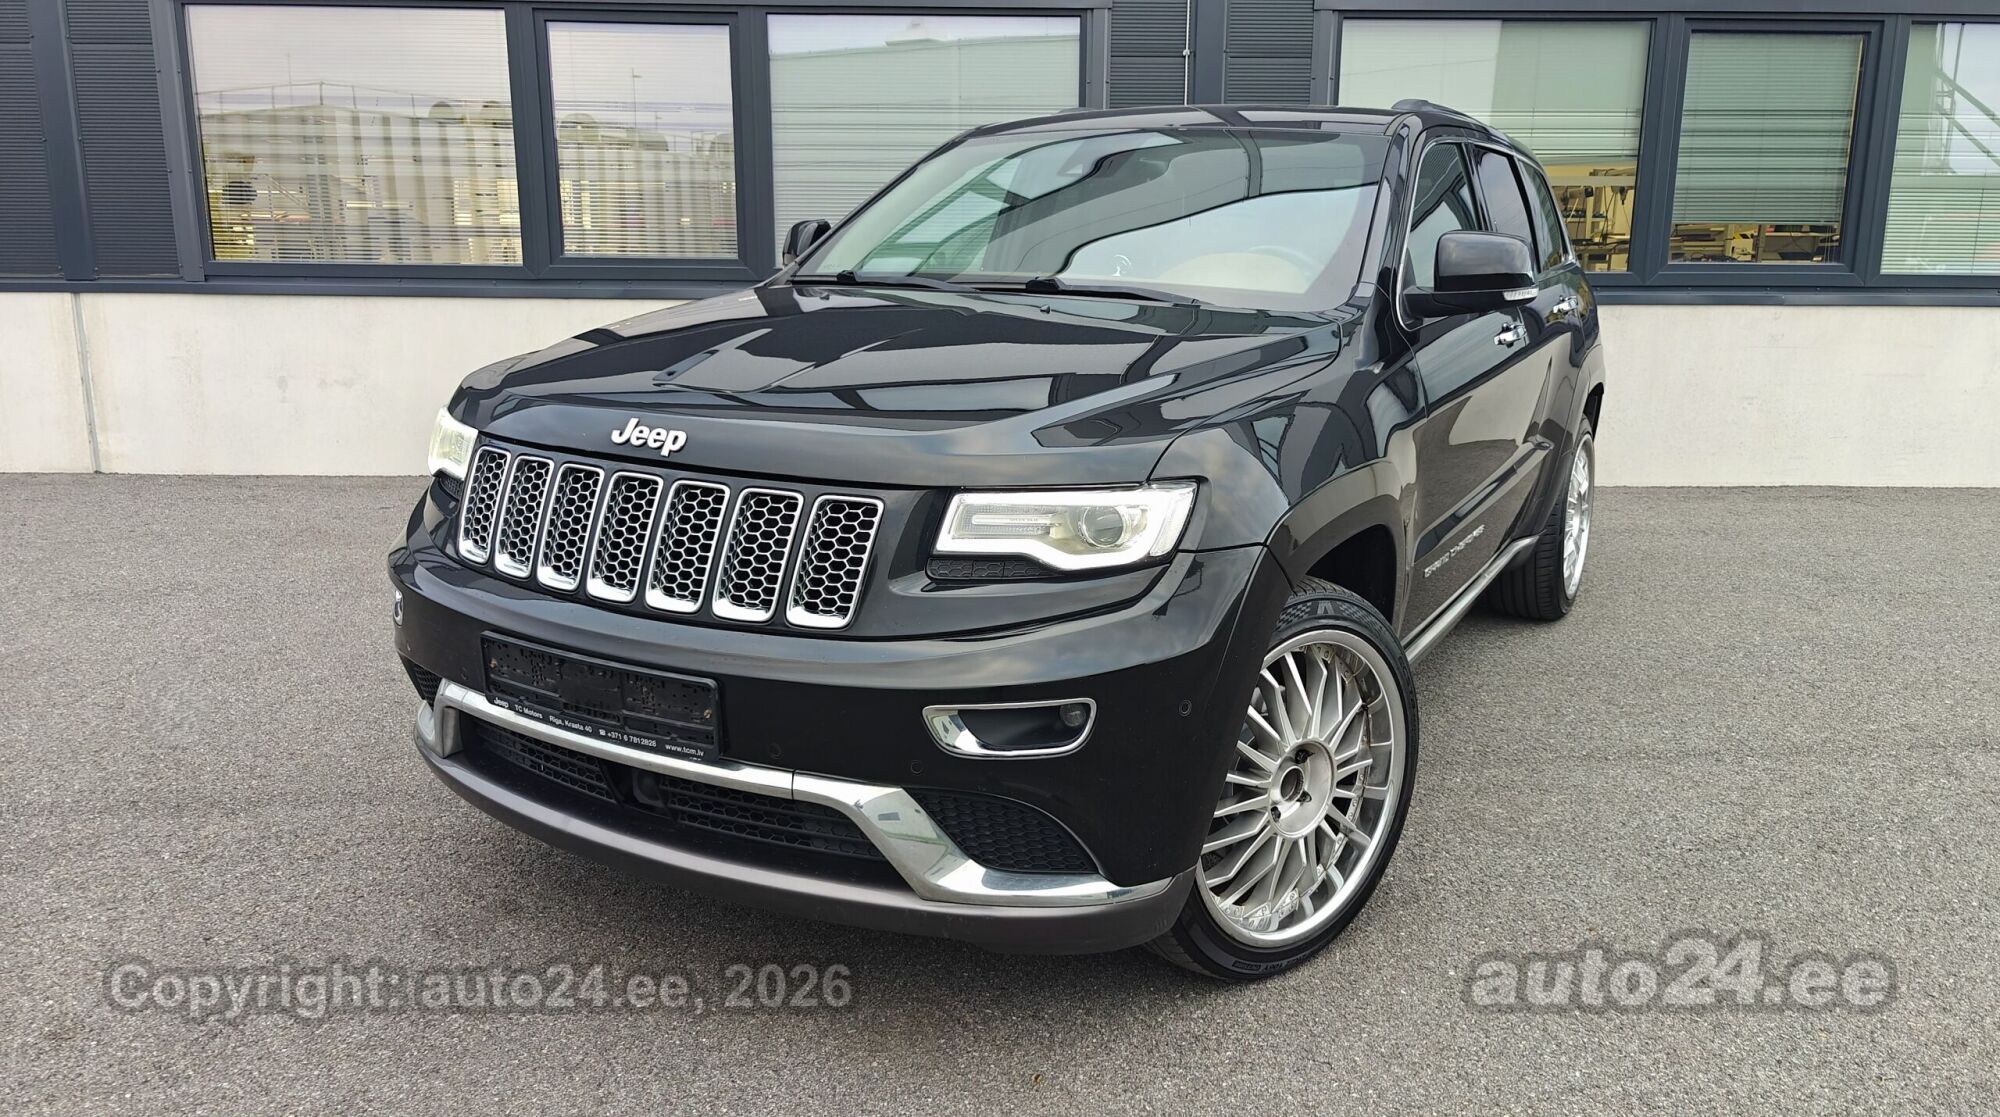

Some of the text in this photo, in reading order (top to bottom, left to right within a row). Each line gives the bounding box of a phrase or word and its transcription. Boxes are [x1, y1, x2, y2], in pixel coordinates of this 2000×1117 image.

[611, 417, 687, 457] Jeep
[494, 697, 509, 708] Jeep
[514, 704, 523, 713] TC
[523, 707, 543, 719] Motors
